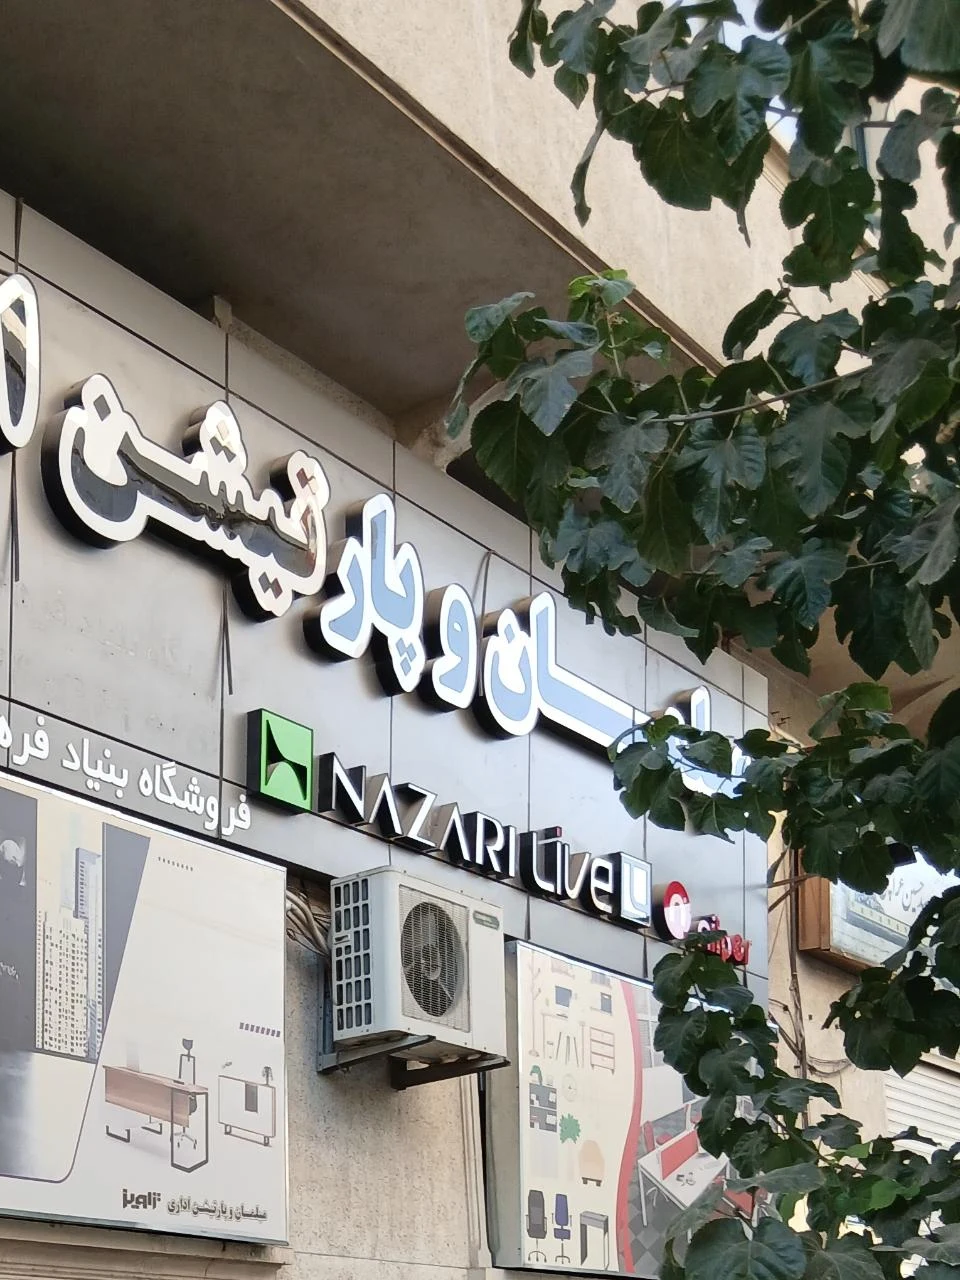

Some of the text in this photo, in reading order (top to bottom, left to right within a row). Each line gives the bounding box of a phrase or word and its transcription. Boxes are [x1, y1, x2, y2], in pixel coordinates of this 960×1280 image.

[430, 583, 478, 709] و
[60, 738, 129, 798] بنیاد
[138, 761, 251, 836] فروشگاه
[319, 752, 517, 878] NAZARI
[167, 1196, 191, 1215] اداری
[235, 1204, 268, 1223] مبلمان
